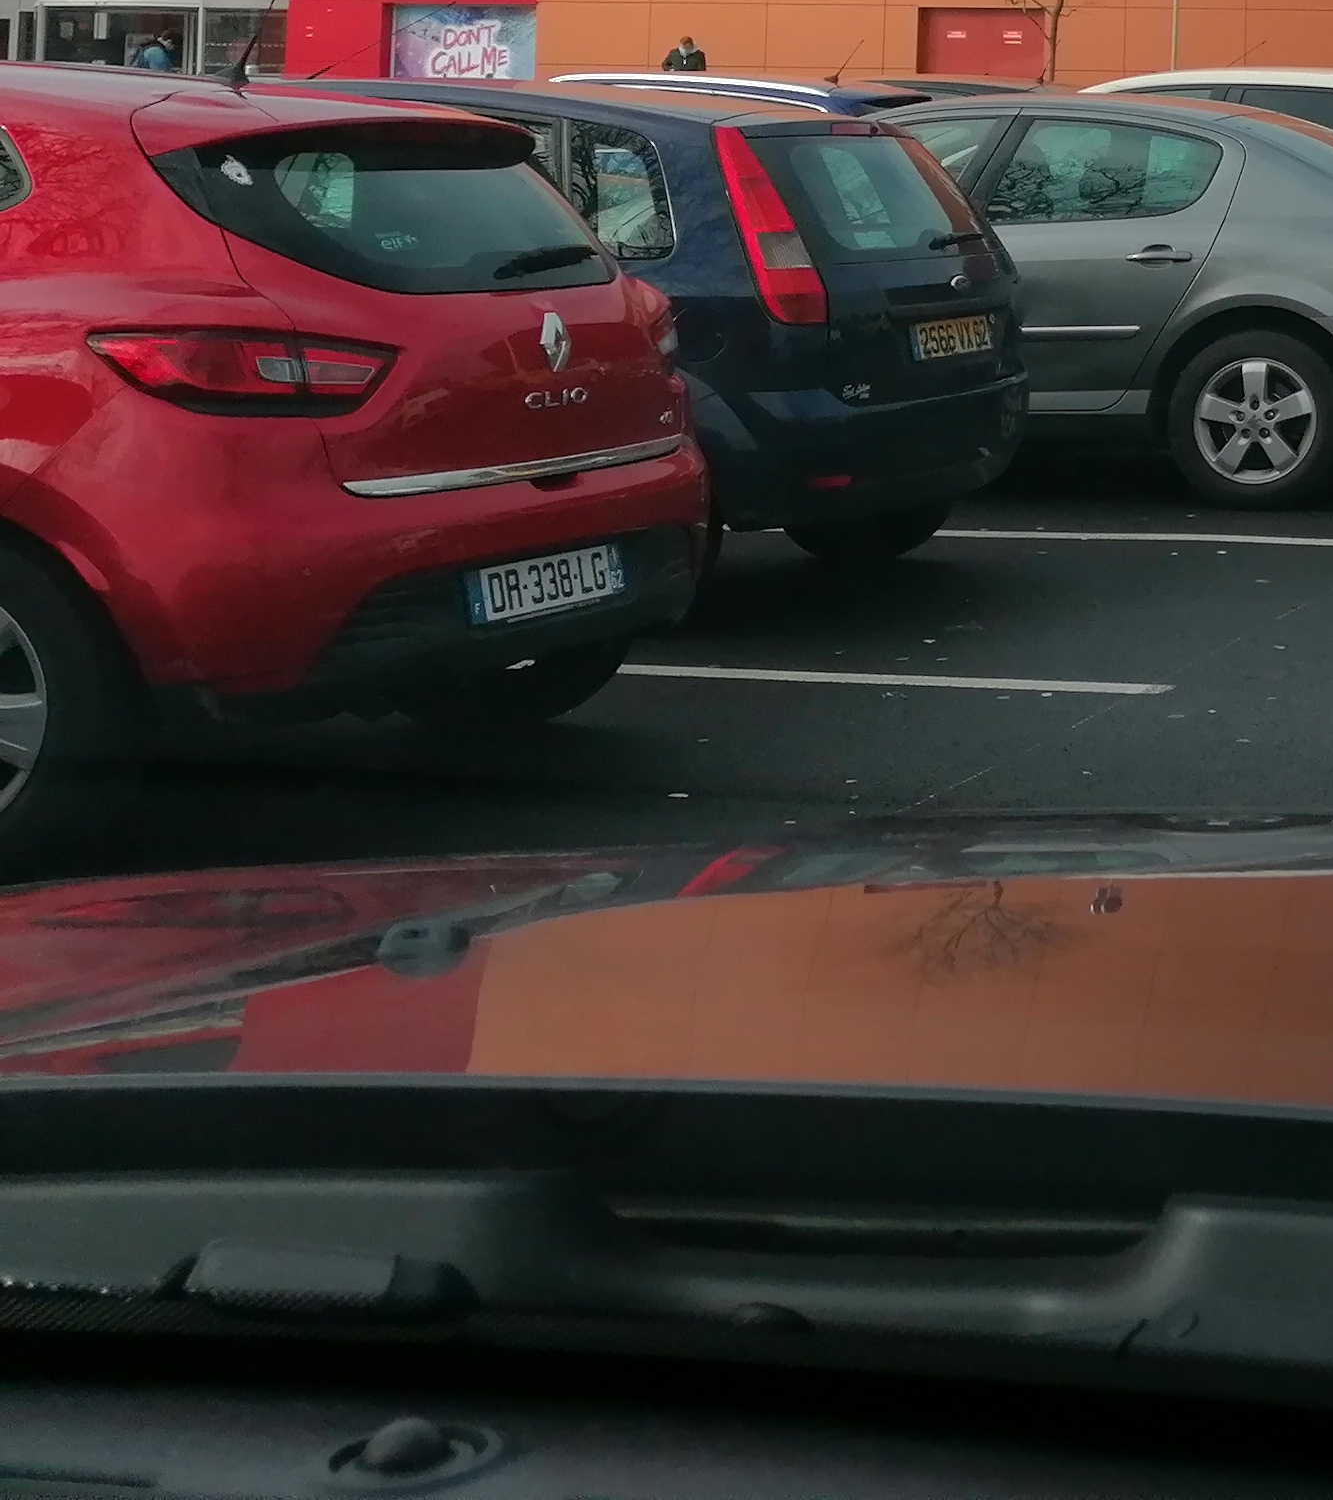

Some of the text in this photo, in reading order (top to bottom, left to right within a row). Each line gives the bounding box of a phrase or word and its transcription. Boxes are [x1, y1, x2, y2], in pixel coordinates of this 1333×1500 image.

[442, 24, 496, 50] DON'T
[431, 46, 508, 76] CALL ME
[524, 386, 589, 410] CLIO
